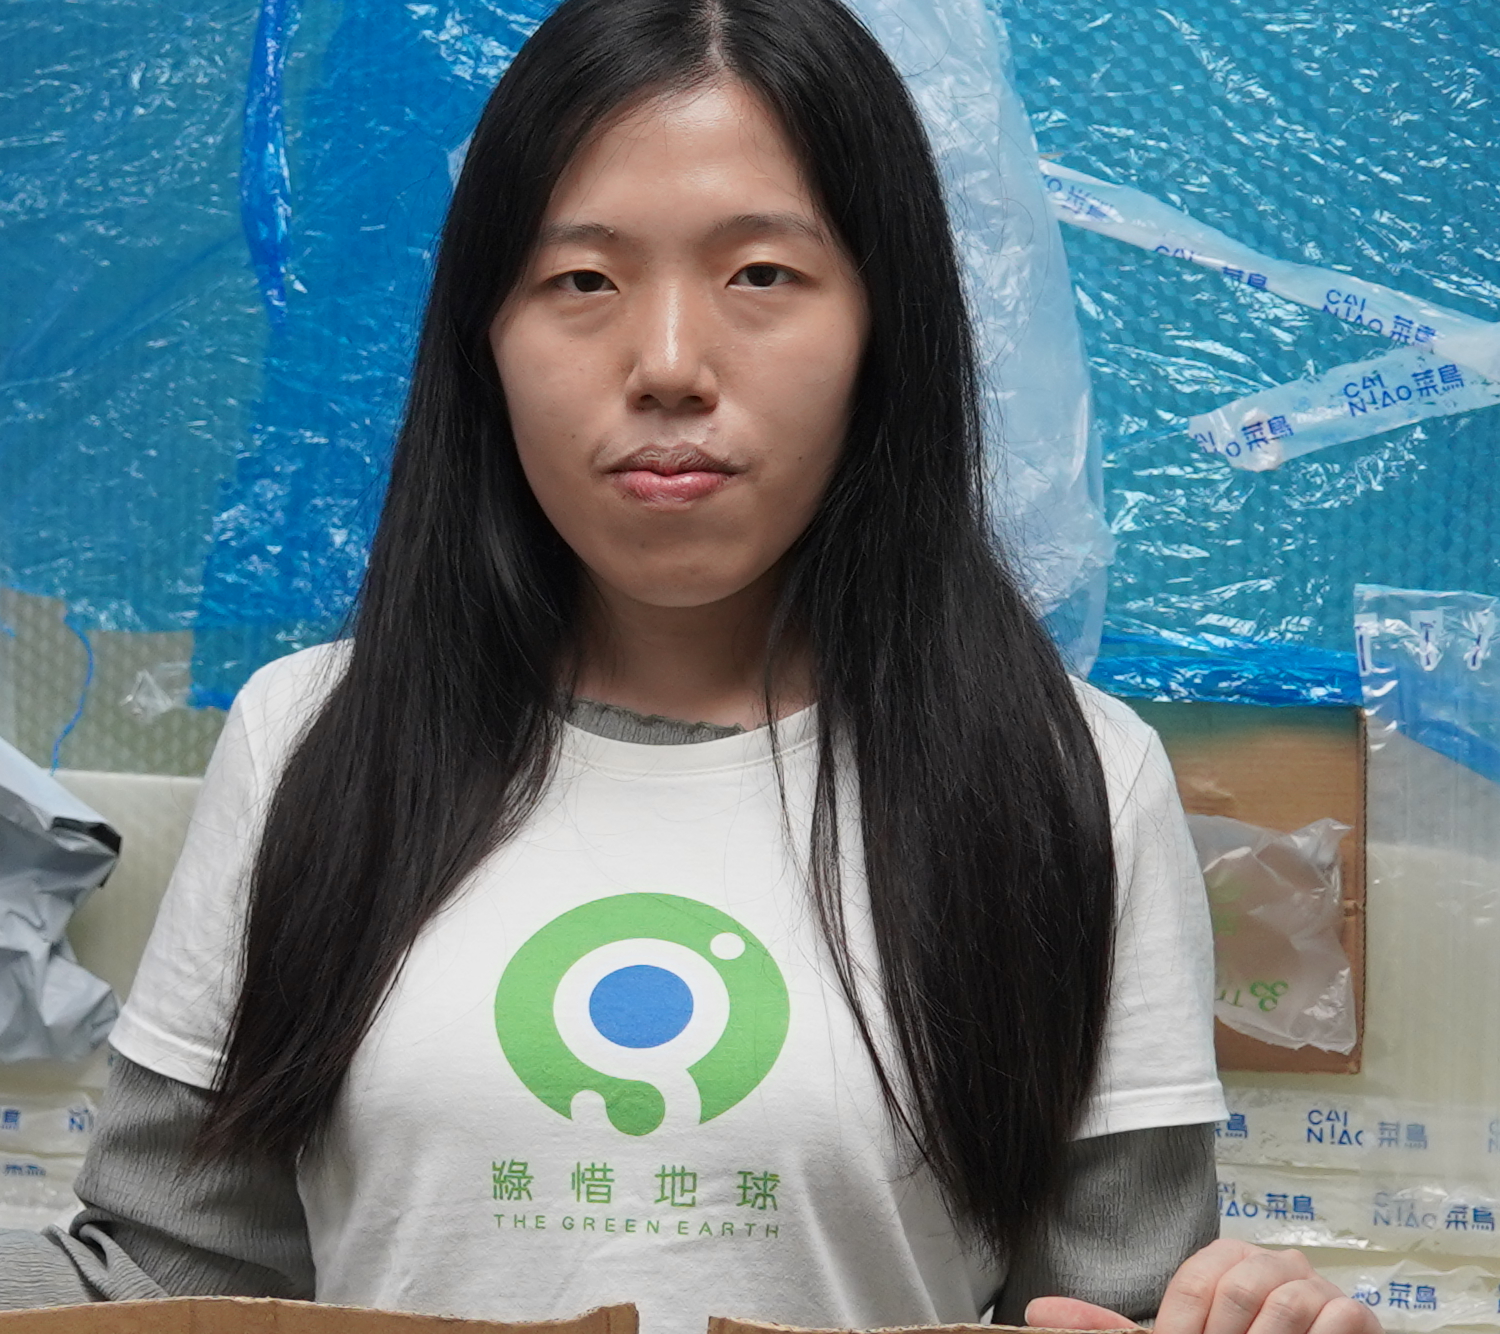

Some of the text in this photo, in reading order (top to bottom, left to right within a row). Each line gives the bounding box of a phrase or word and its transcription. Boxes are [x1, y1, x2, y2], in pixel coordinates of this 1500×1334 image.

[1325, 287, 1367, 312] CAI
[1343, 373, 1387, 399] CAI
[1413, 364, 1466, 396] 菜鳥
[1349, 386, 1412, 418] NIAO
[1307, 1109, 1349, 1126] CAI
[1377, 1121, 1428, 1150] 菜鳥
[491, 1158, 782, 1212] 綠惜地球
[1218, 1196, 1259, 1219] IAO
[1265, 1192, 1315, 1221] 菜鳥
[1444, 1204, 1496, 1232] 菜鳥
[493, 1213, 780, 1240] THE GREEN EARTH
[1389, 1281, 1437, 1312] 菜鳥
